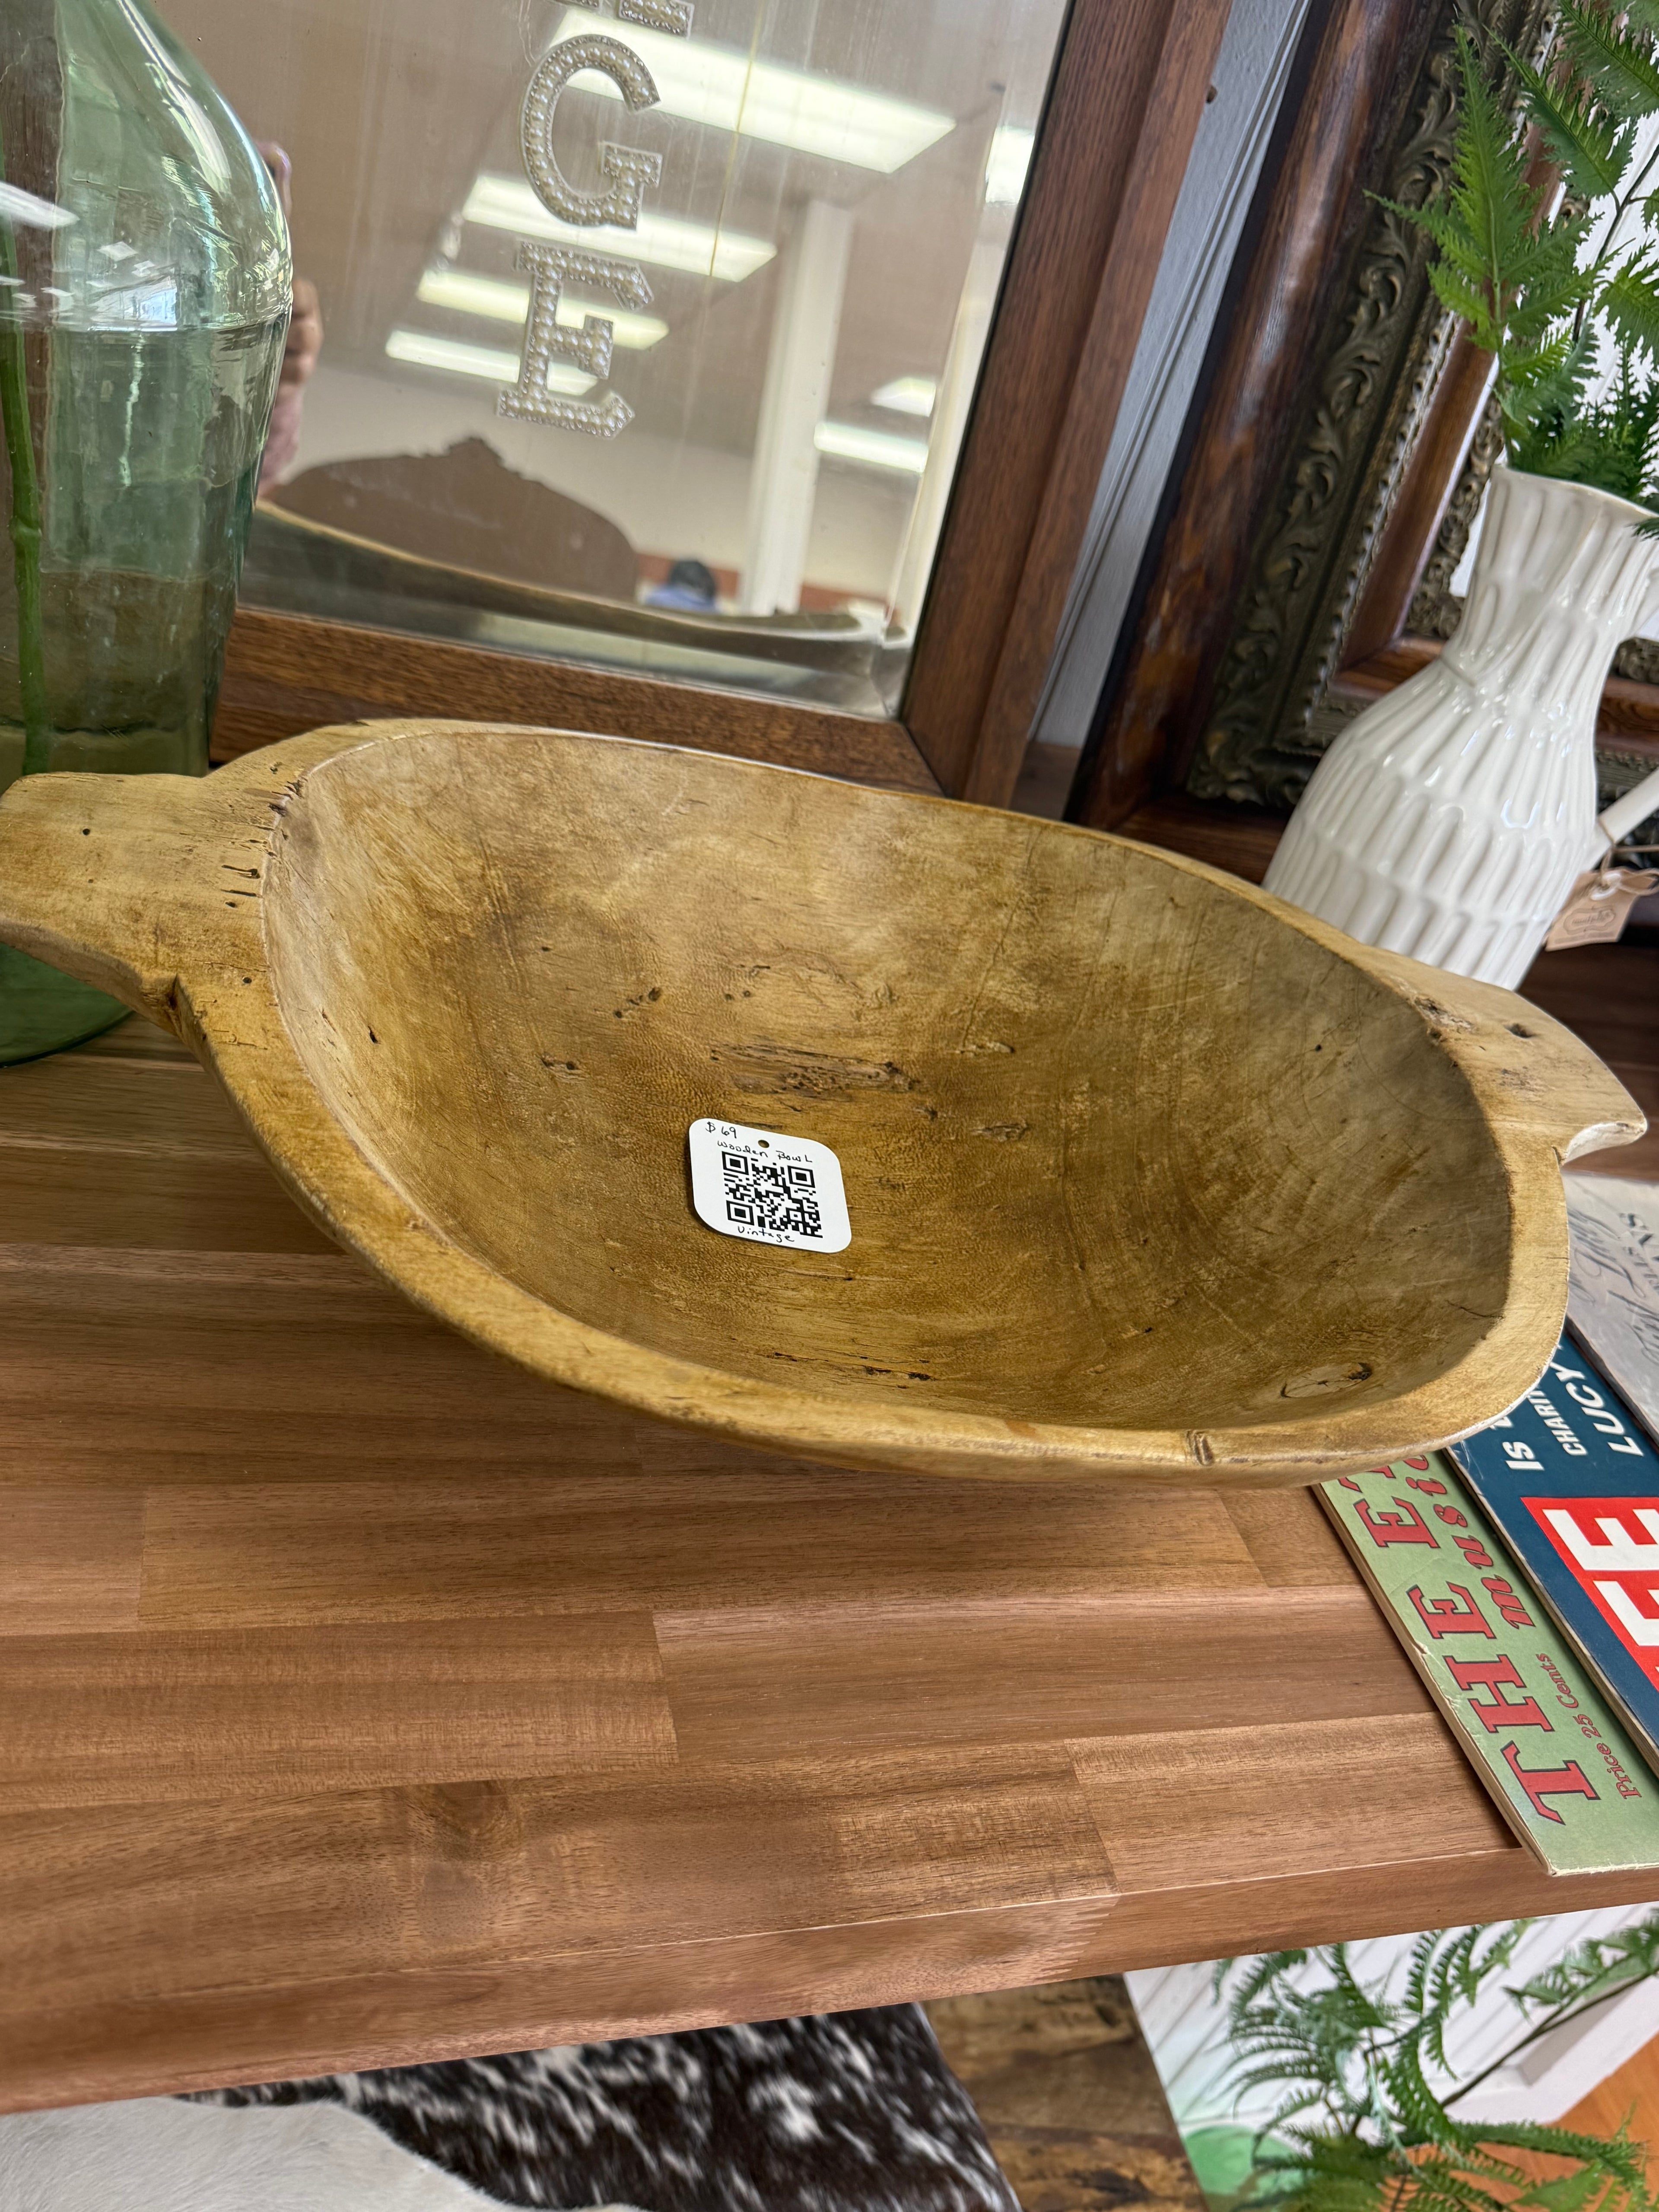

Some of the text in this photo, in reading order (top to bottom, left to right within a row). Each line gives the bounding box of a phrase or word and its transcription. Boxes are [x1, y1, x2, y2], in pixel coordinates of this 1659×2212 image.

[497, 0, 693, 439] GE
[1550, 1362, 1644, 1457] LUCY
[1406, 1580, 1602, 1825] THE
[1535, 1653, 1643, 1800] Price 25 Cents
